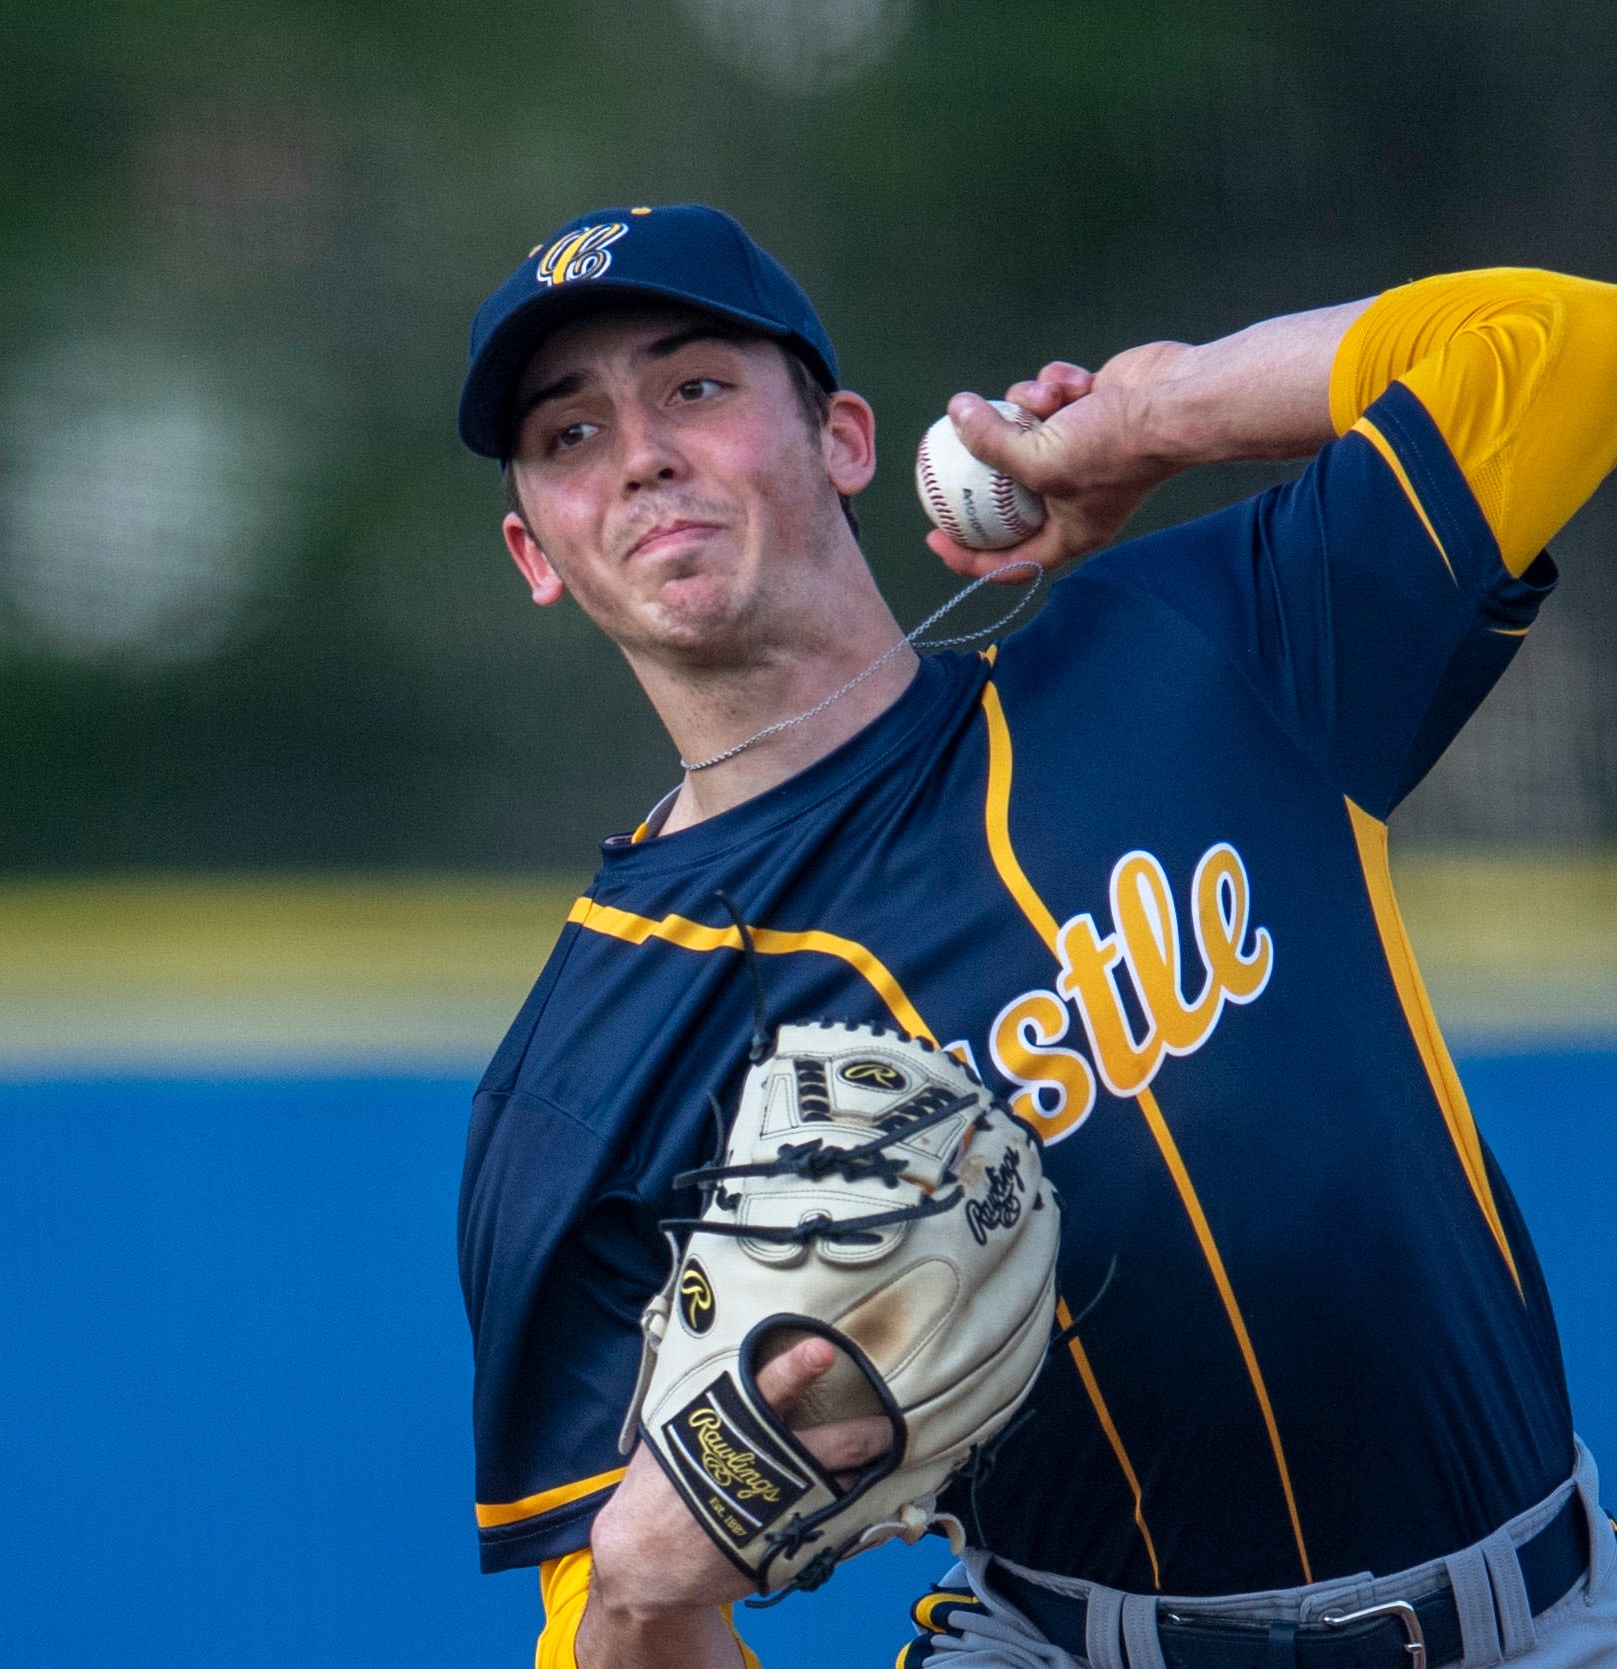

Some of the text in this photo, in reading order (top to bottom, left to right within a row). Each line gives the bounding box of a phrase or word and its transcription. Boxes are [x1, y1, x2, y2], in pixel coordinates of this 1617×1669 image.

[940, 842, 1274, 1147] stle
[681, 1269, 712, 1329] R
[688, 1408, 780, 1502] Rawlings
